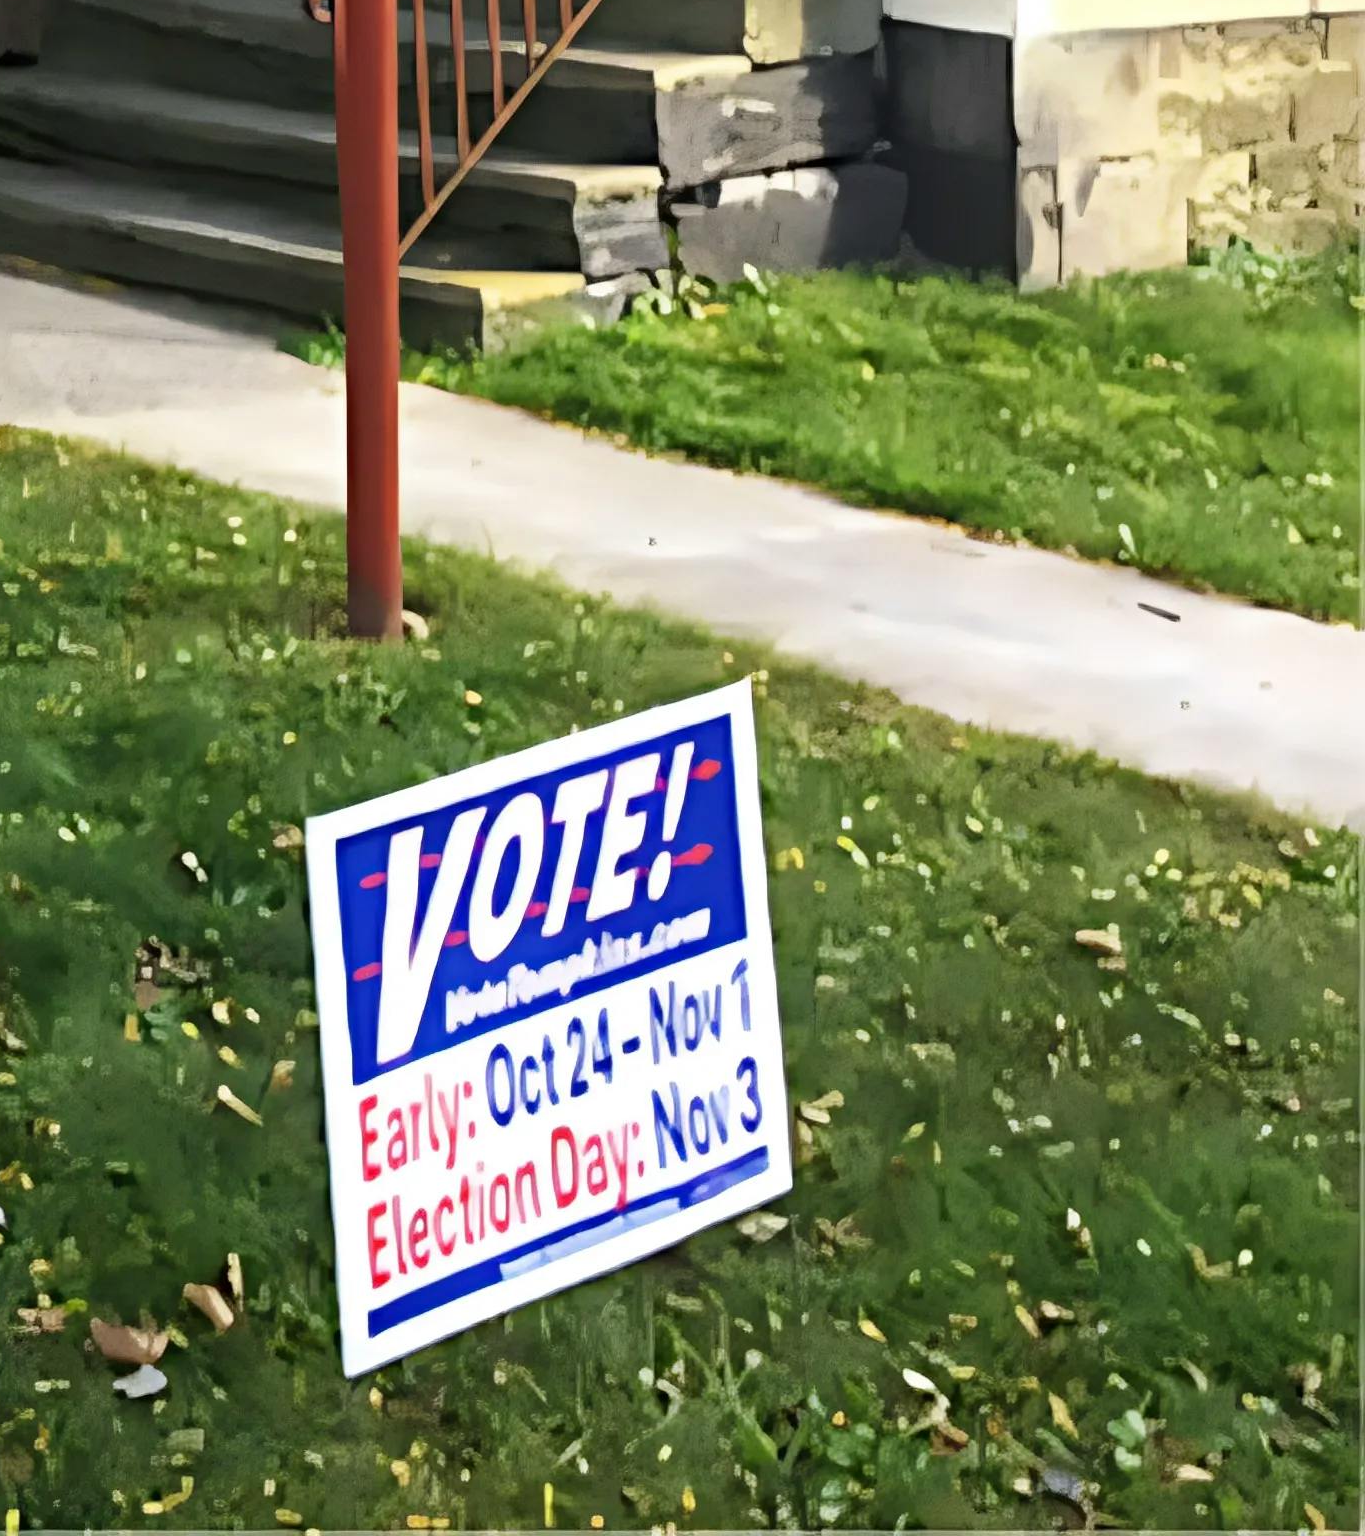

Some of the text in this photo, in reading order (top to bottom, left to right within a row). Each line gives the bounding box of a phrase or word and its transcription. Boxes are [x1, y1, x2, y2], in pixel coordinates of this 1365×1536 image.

[376, 741, 695, 1064] VOTE!
[357, 1072, 478, 1182] Early:
[485, 1032, 558, 1127] Oct
[648, 980, 723, 1066] Nov
[730, 958, 753, 1033] 1
[369, 1158, 543, 1290] Election
[550, 1121, 645, 1212] Day:
[650, 1080, 733, 1170] Nov
[738, 1055, 762, 1133] 3
